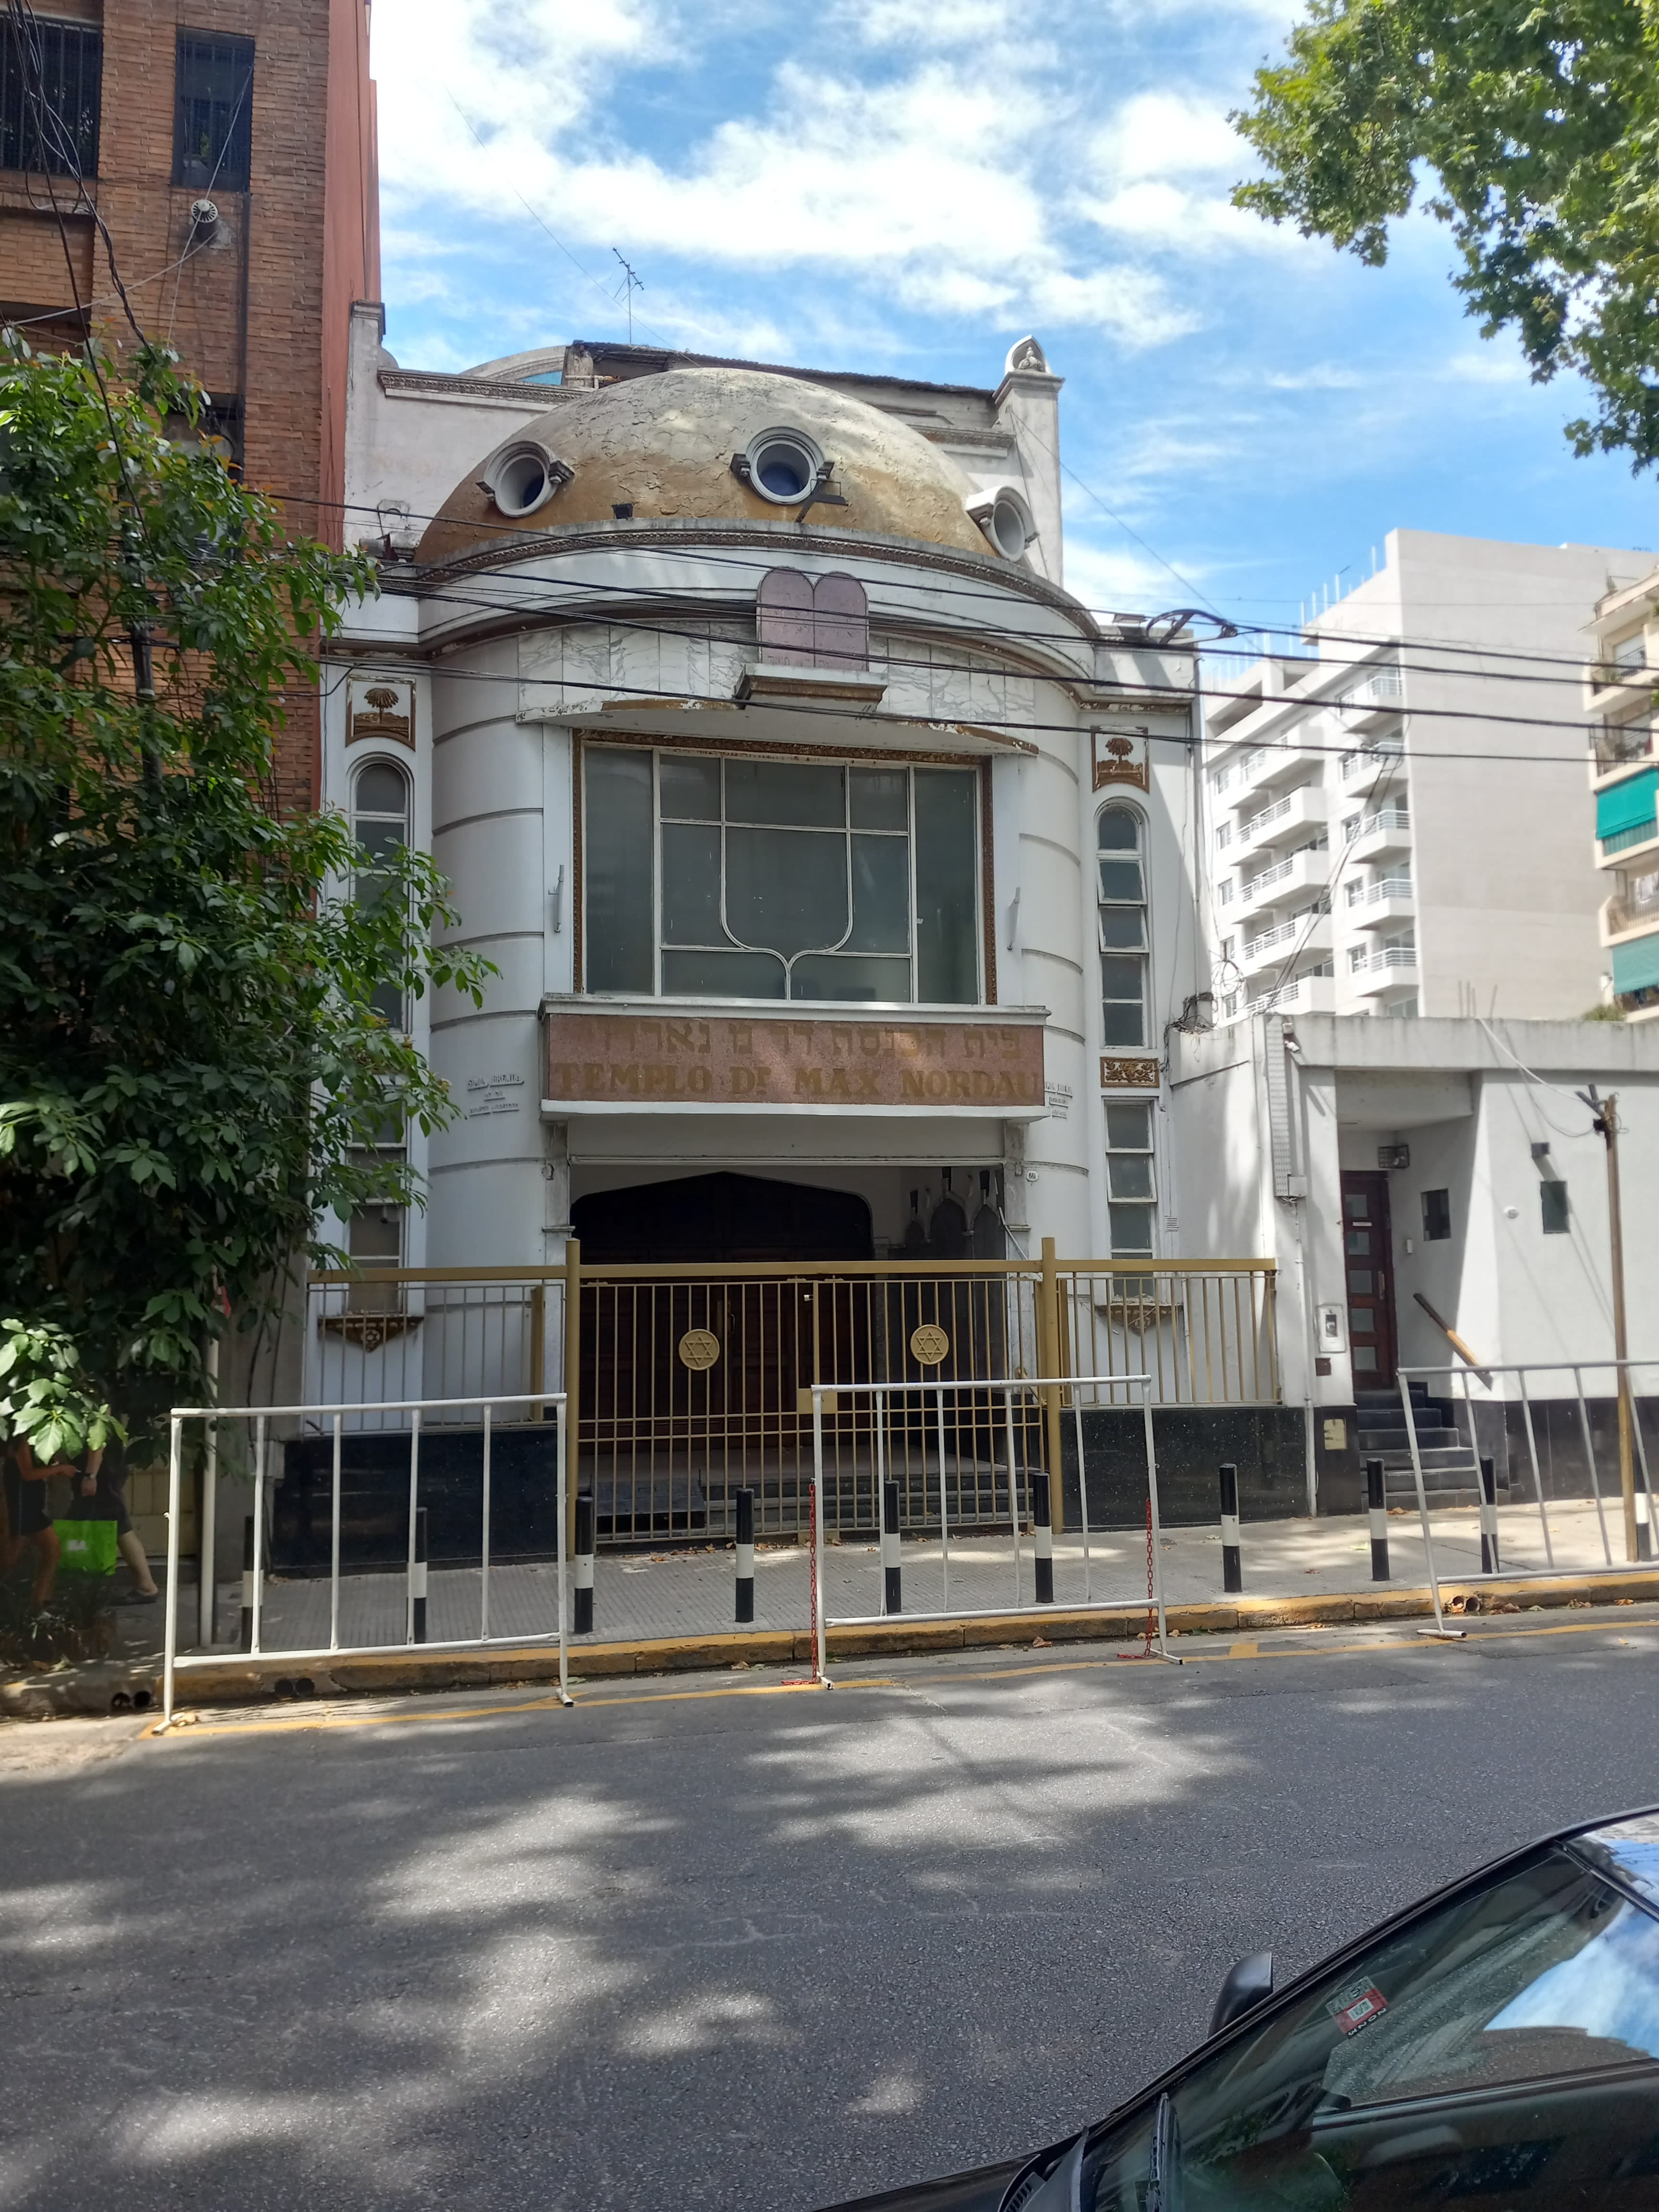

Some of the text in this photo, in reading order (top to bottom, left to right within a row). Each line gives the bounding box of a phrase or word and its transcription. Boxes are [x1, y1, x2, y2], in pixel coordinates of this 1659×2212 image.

[555, 1063, 713, 1094] TEMPLO
[793, 1067, 880, 1095] MAX
[900, 1070, 1039, 1098] NORDAU
[1348, 2008, 1387, 2036] 2023
